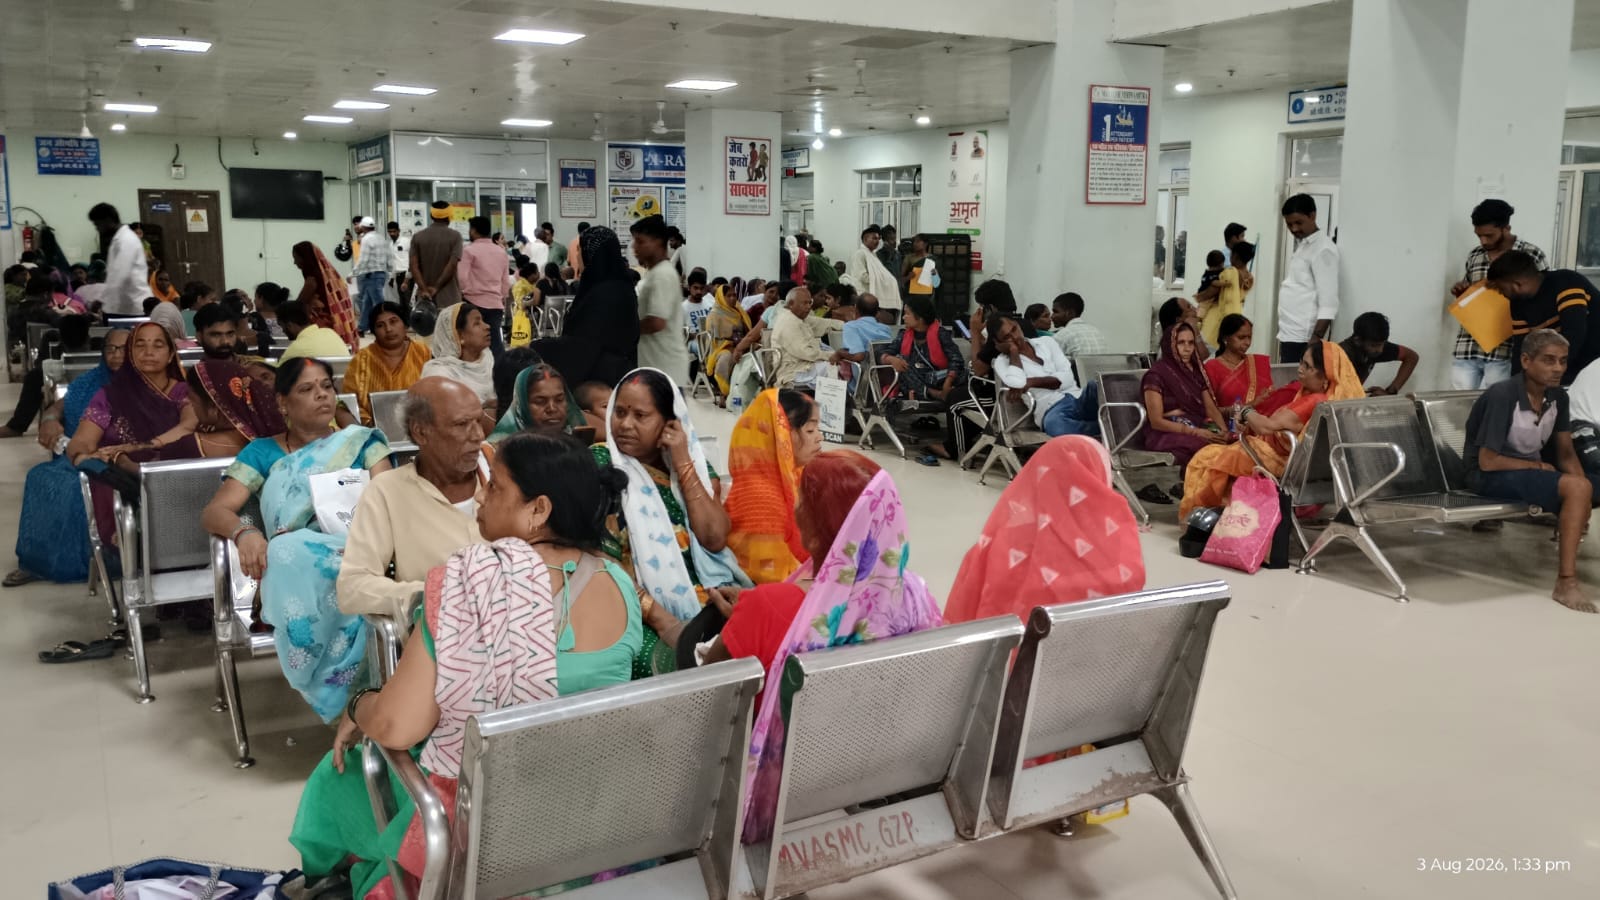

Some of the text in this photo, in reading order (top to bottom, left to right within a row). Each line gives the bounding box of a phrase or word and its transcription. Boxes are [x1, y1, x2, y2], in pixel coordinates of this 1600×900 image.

[1103, 114, 1111, 142] 1
[729, 139, 743, 153] जेब
[648, 152, 685, 167] X-RA
[729, 154, 749, 167] कतरों
[729, 168, 736, 181] से
[729, 183, 767, 197] सावधान
[949, 202, 981, 224] अमृत
[825, 432, 843, 443] SCAN
